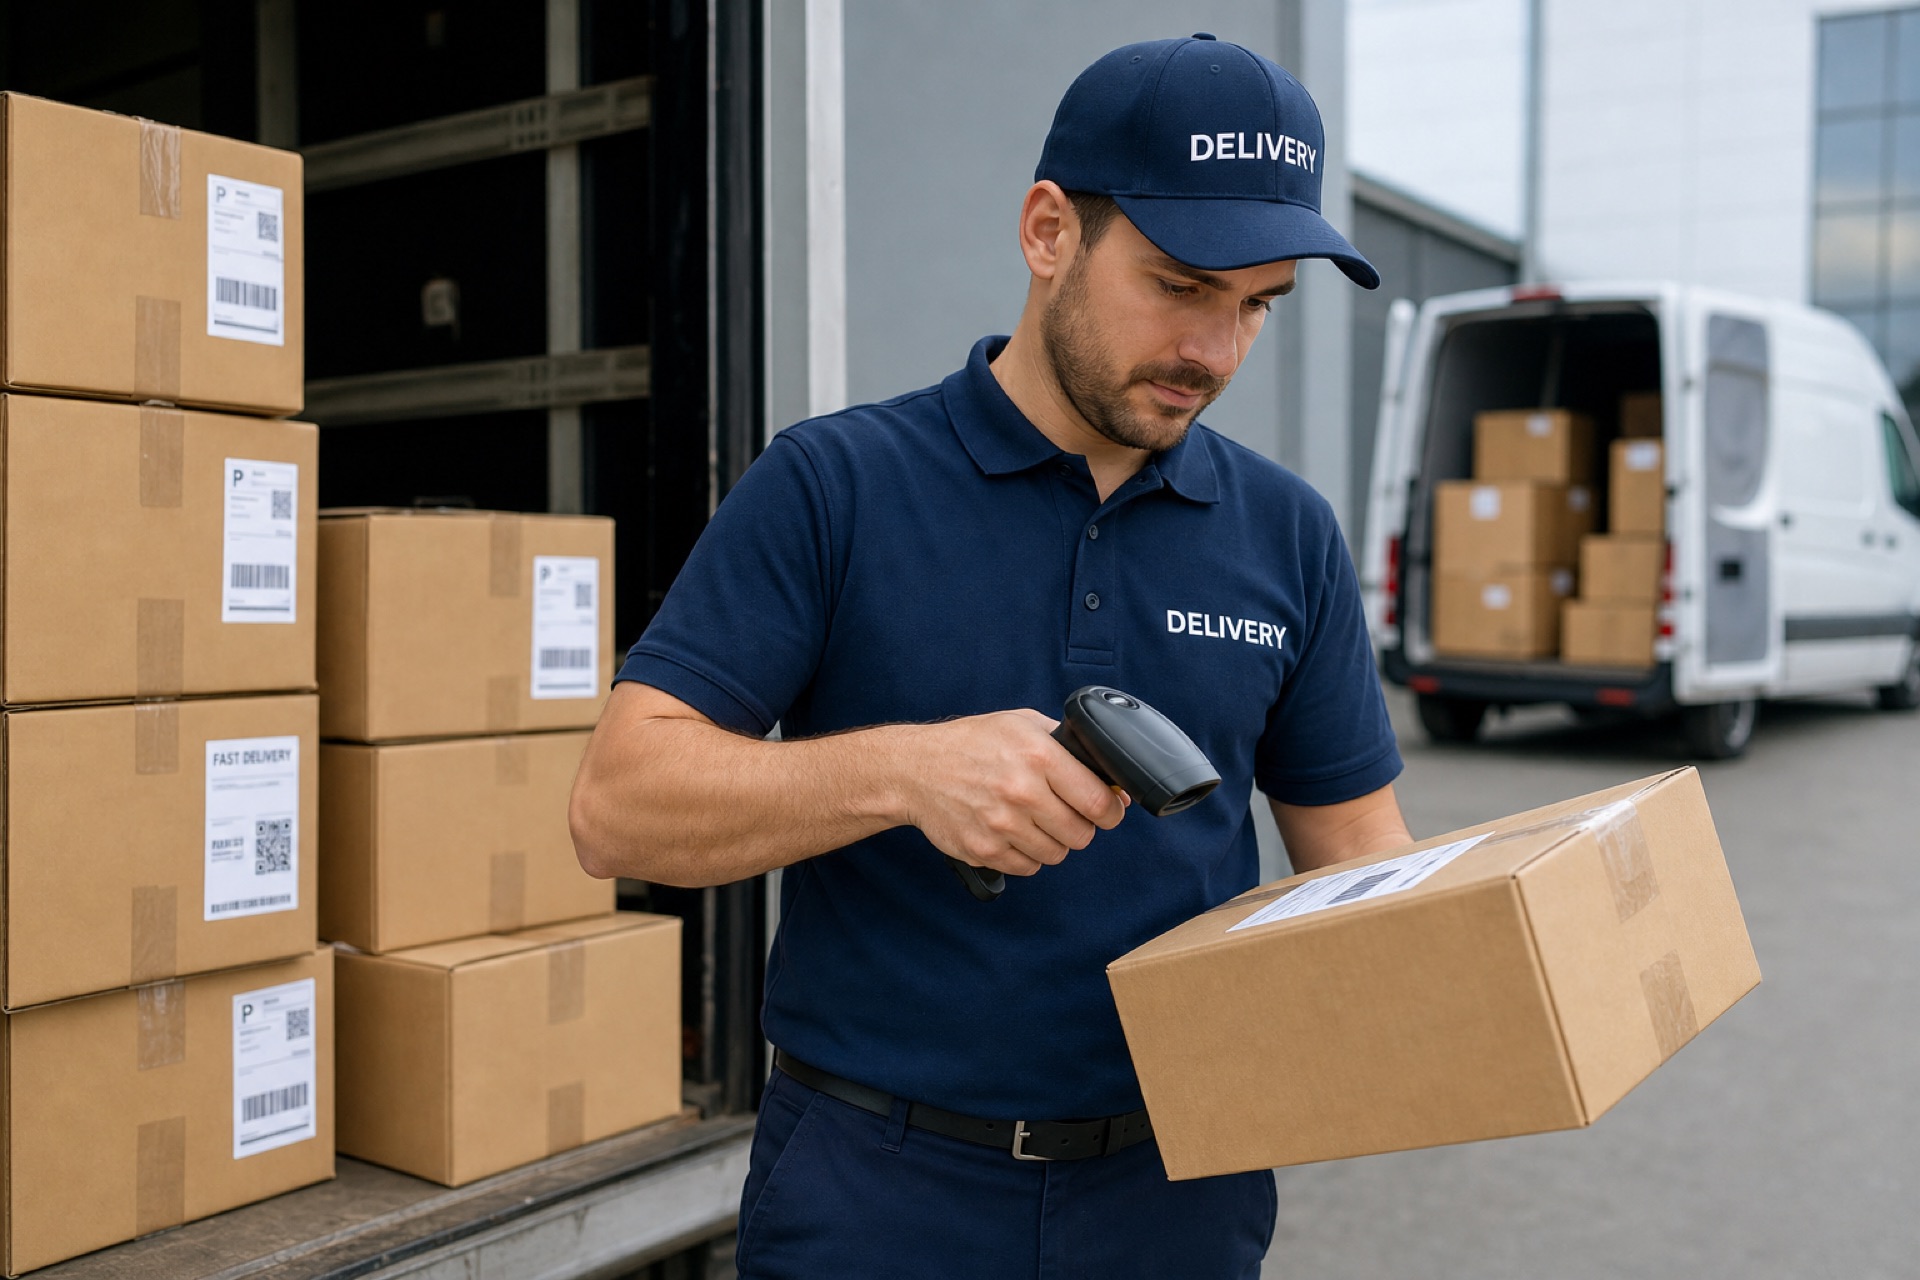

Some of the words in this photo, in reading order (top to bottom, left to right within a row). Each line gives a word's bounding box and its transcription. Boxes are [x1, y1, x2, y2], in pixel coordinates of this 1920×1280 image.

[1191, 132, 1317, 174] DELIVERY
[215, 185, 227, 203] P
[233, 469, 244, 488] P
[1166, 609, 1287, 650] DELIVERY
[213, 751, 240, 766] FAST
[243, 749, 291, 765] DELIVERY
[241, 1004, 254, 1024] P
